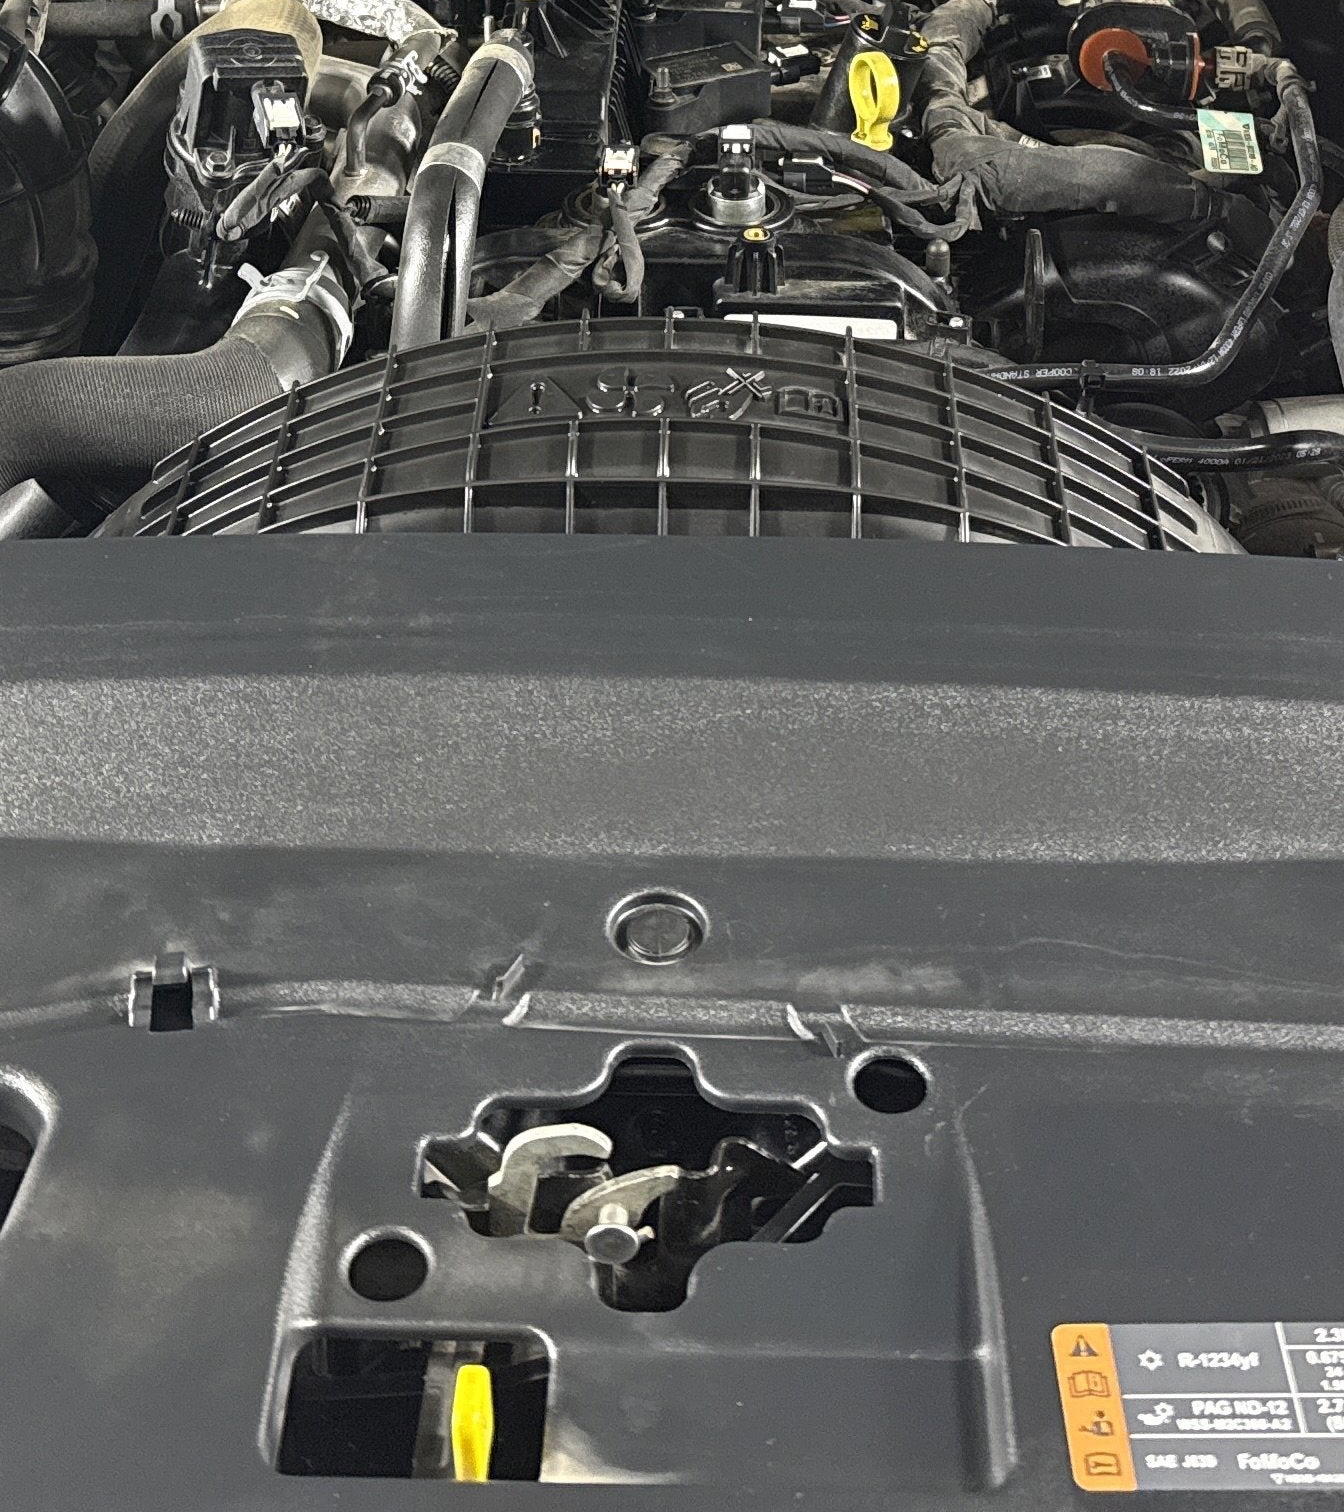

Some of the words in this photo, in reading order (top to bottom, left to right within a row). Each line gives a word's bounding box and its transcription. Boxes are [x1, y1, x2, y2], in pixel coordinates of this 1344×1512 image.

[1035, 367, 1073, 378] COOPER
[1176, 1352, 1260, 1371] R-1234yf
[1190, 1400, 1232, 1415] PAG
[1234, 1400, 1290, 1415] ND-12
[1315, 1398, 1344, 1414] 2.7
[1144, 1454, 1178, 1468] SAE
[1235, 1451, 1321, 1470] FoMoCo
